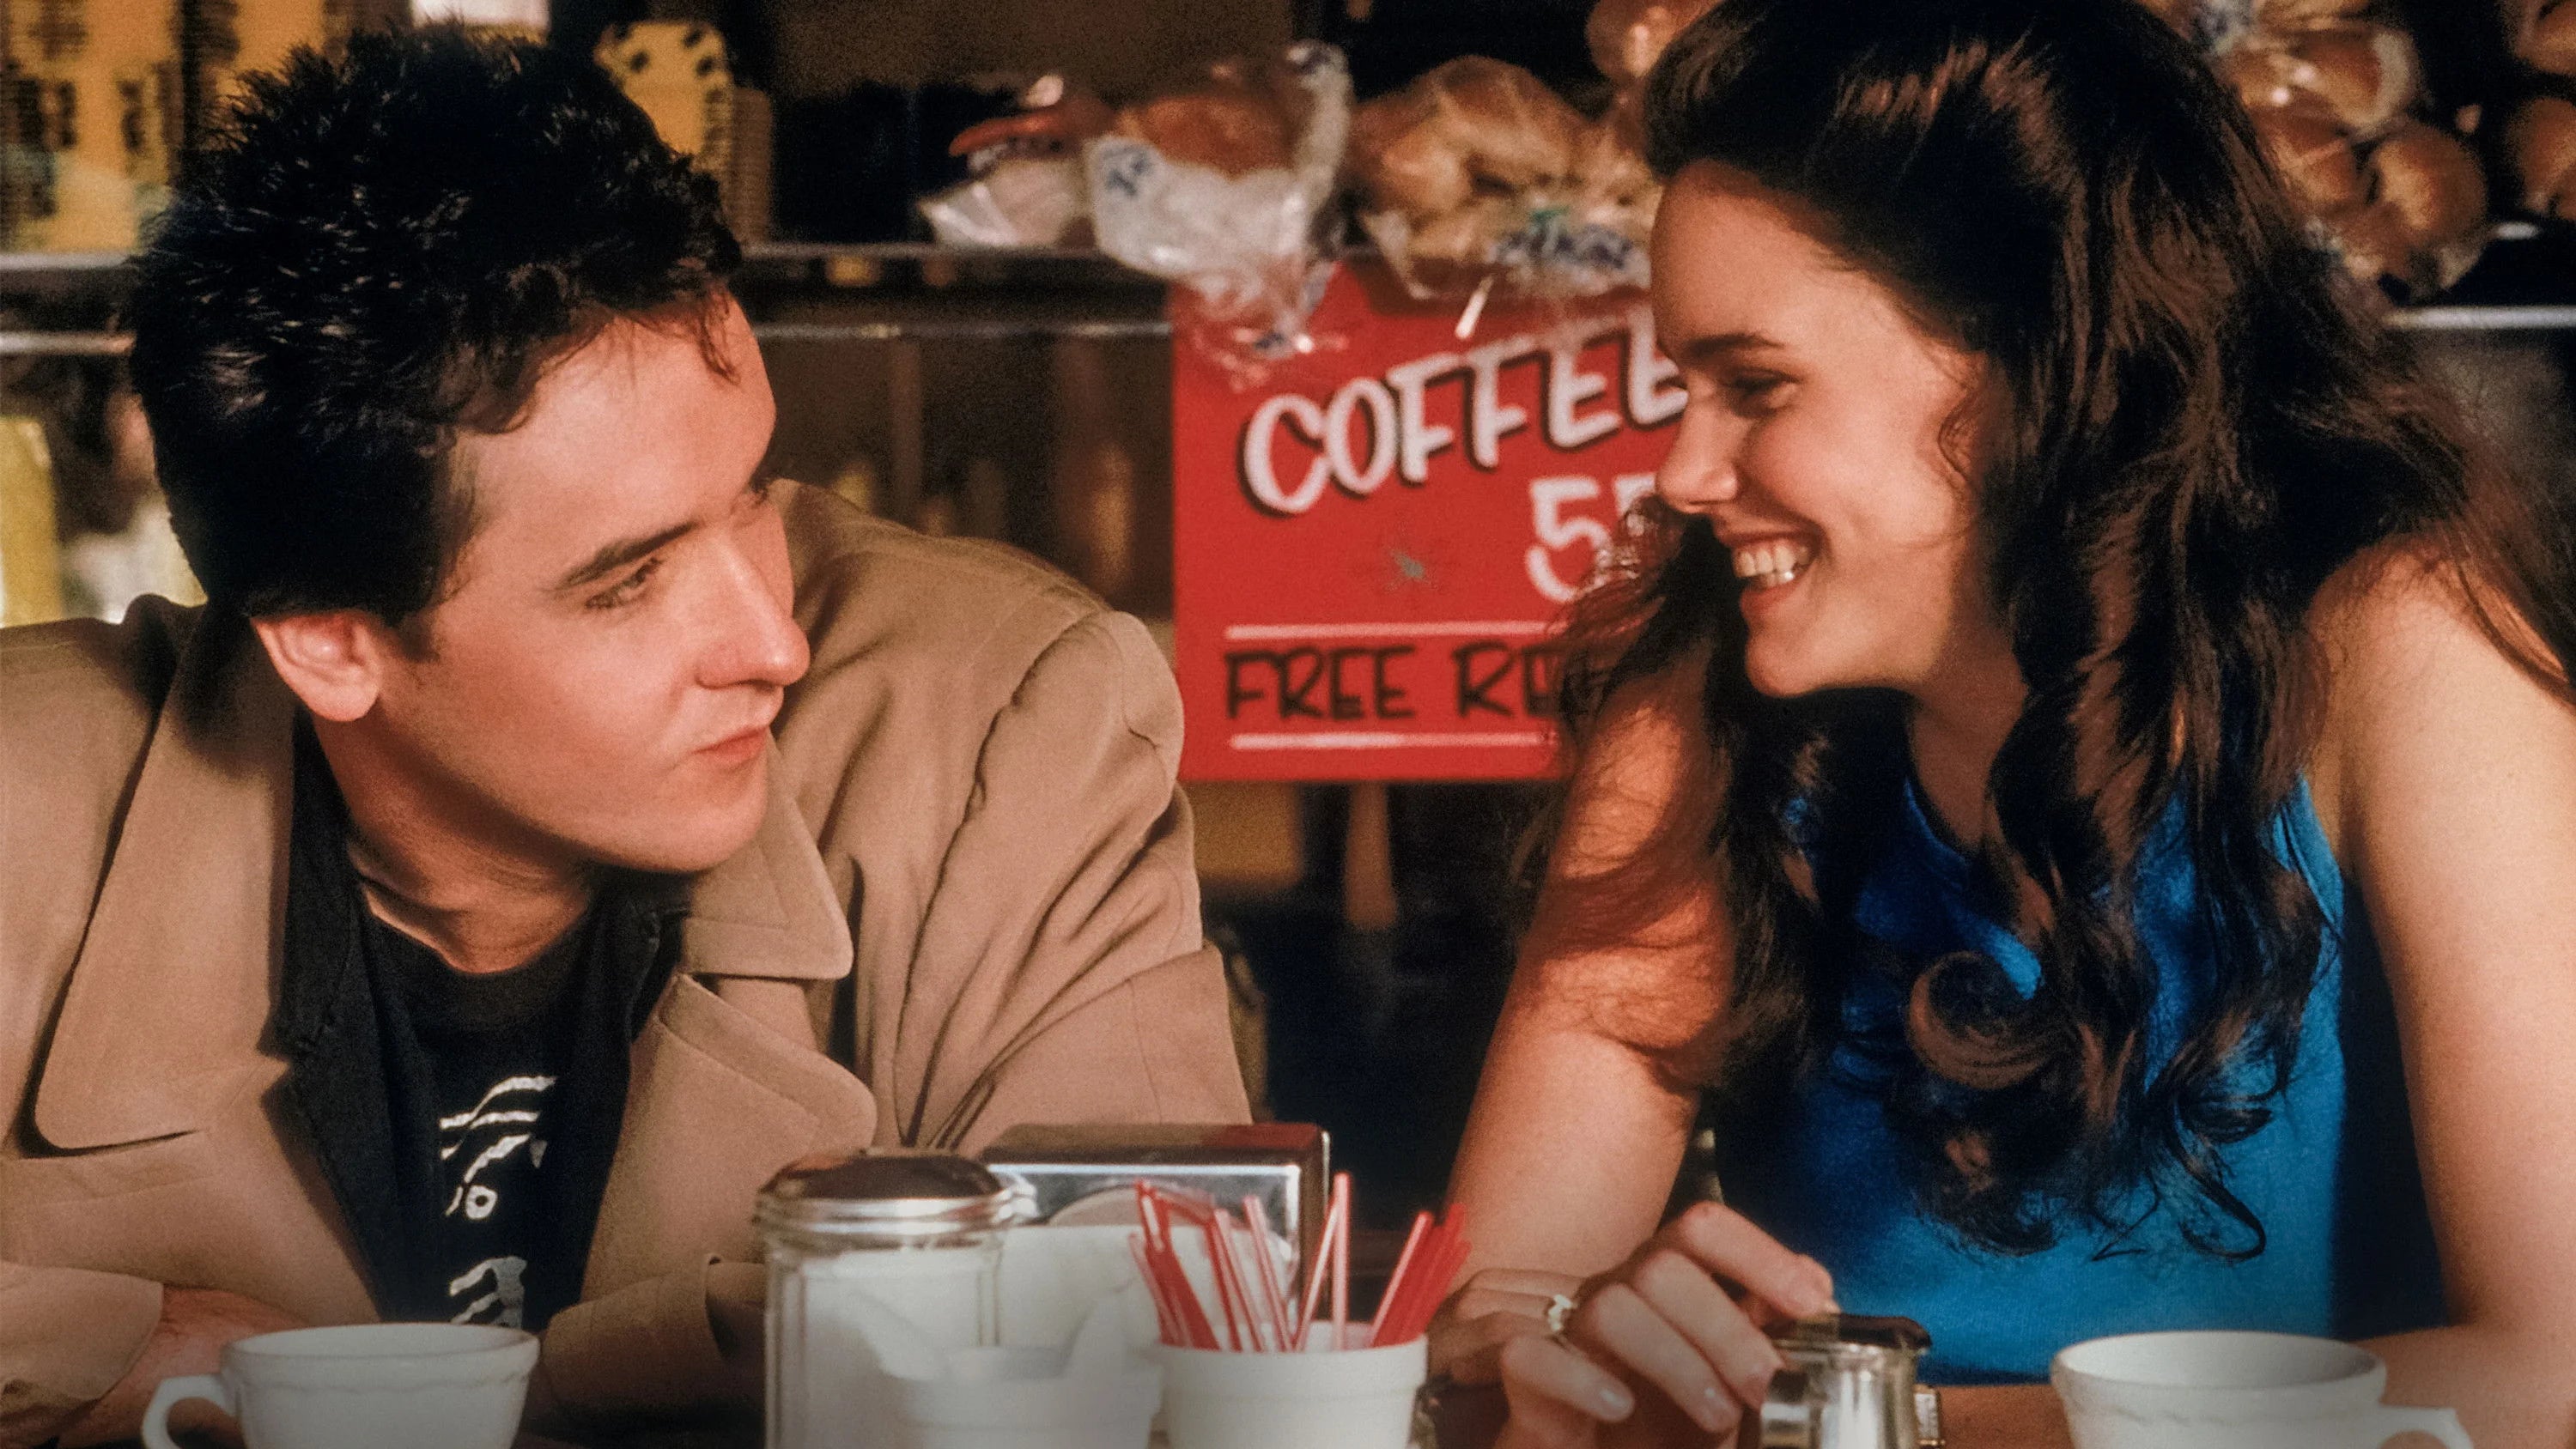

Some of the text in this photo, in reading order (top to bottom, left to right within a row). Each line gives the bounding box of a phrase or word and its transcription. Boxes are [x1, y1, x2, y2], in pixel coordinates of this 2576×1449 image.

[1240, 304, 1689, 515] COFFEE
[1225, 640, 1564, 719] FREE RE
